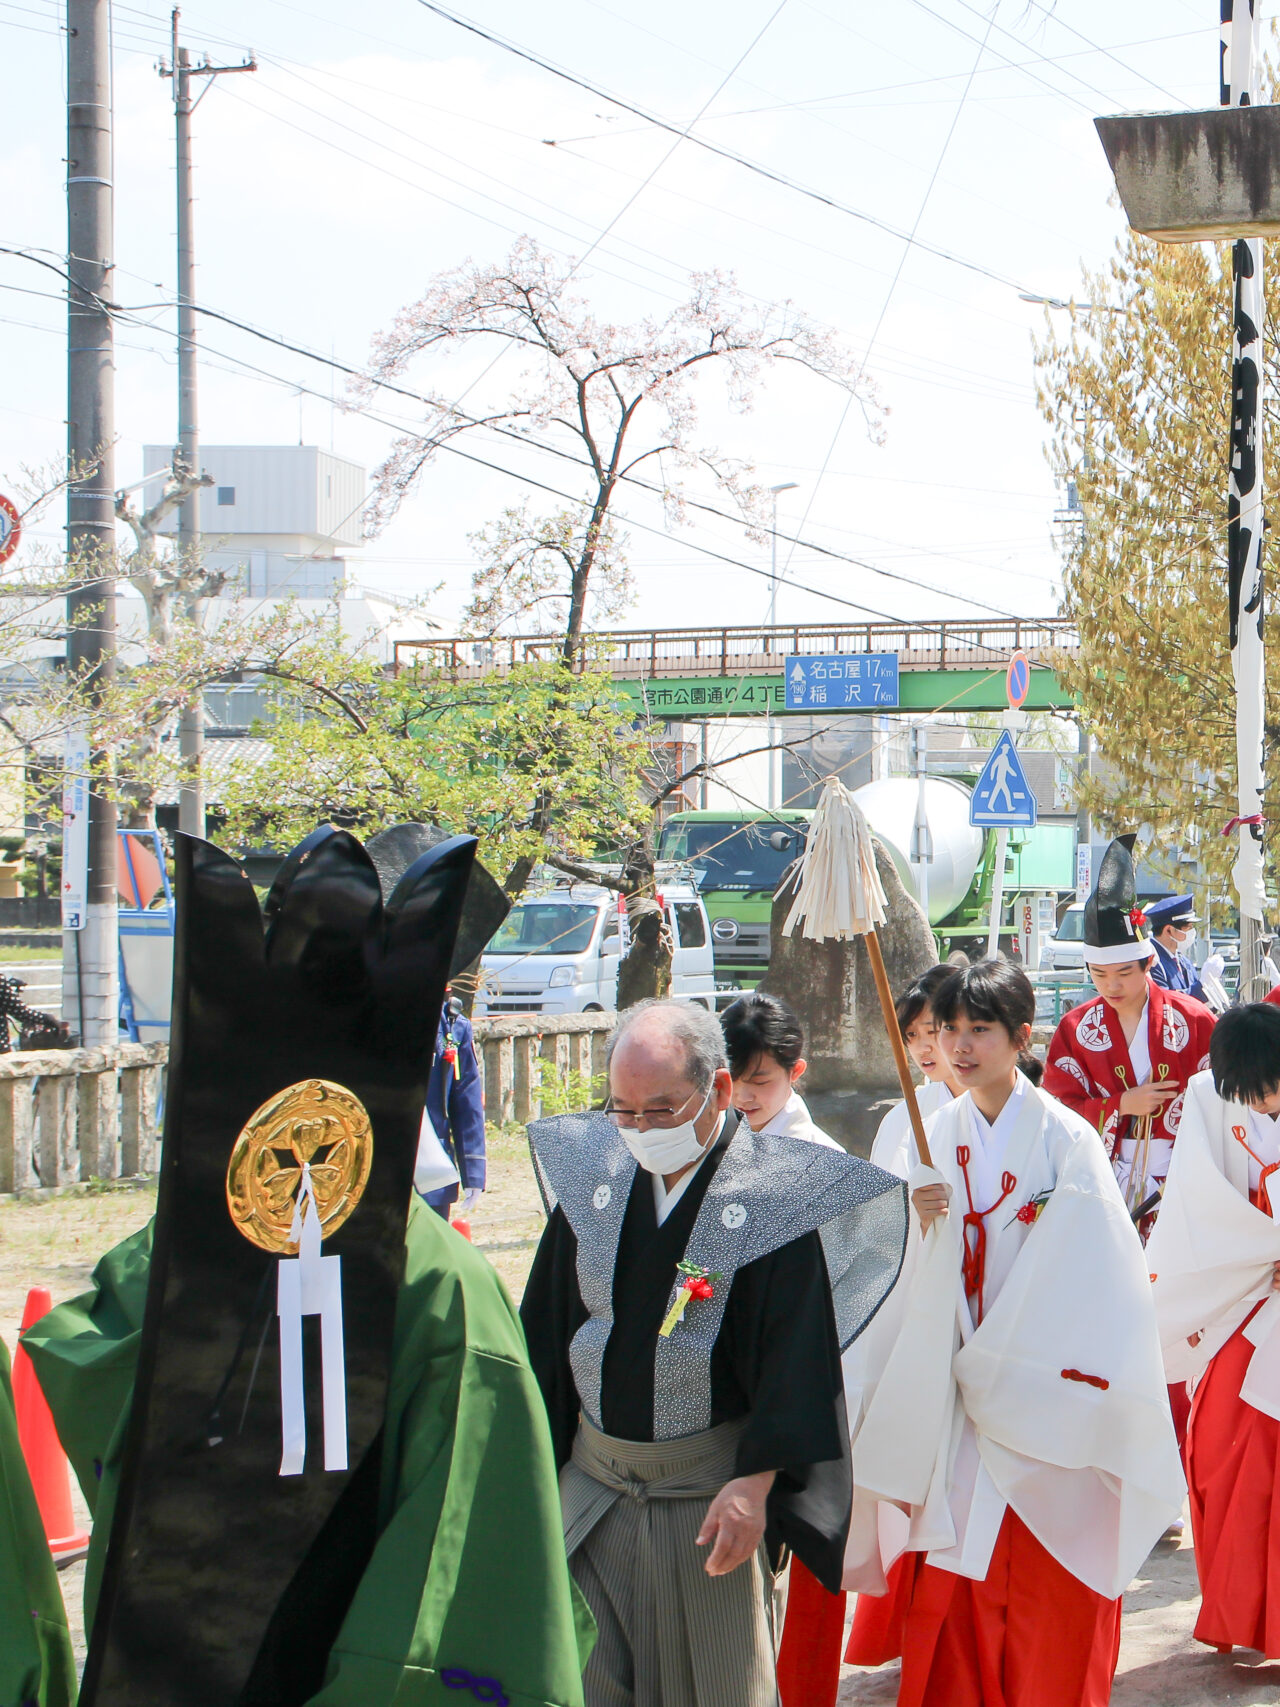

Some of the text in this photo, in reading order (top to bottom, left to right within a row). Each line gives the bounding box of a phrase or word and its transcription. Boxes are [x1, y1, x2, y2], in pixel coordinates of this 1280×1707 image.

[809, 661, 861, 679] 名古屋
[1025, 906, 1033, 934] DyDo
